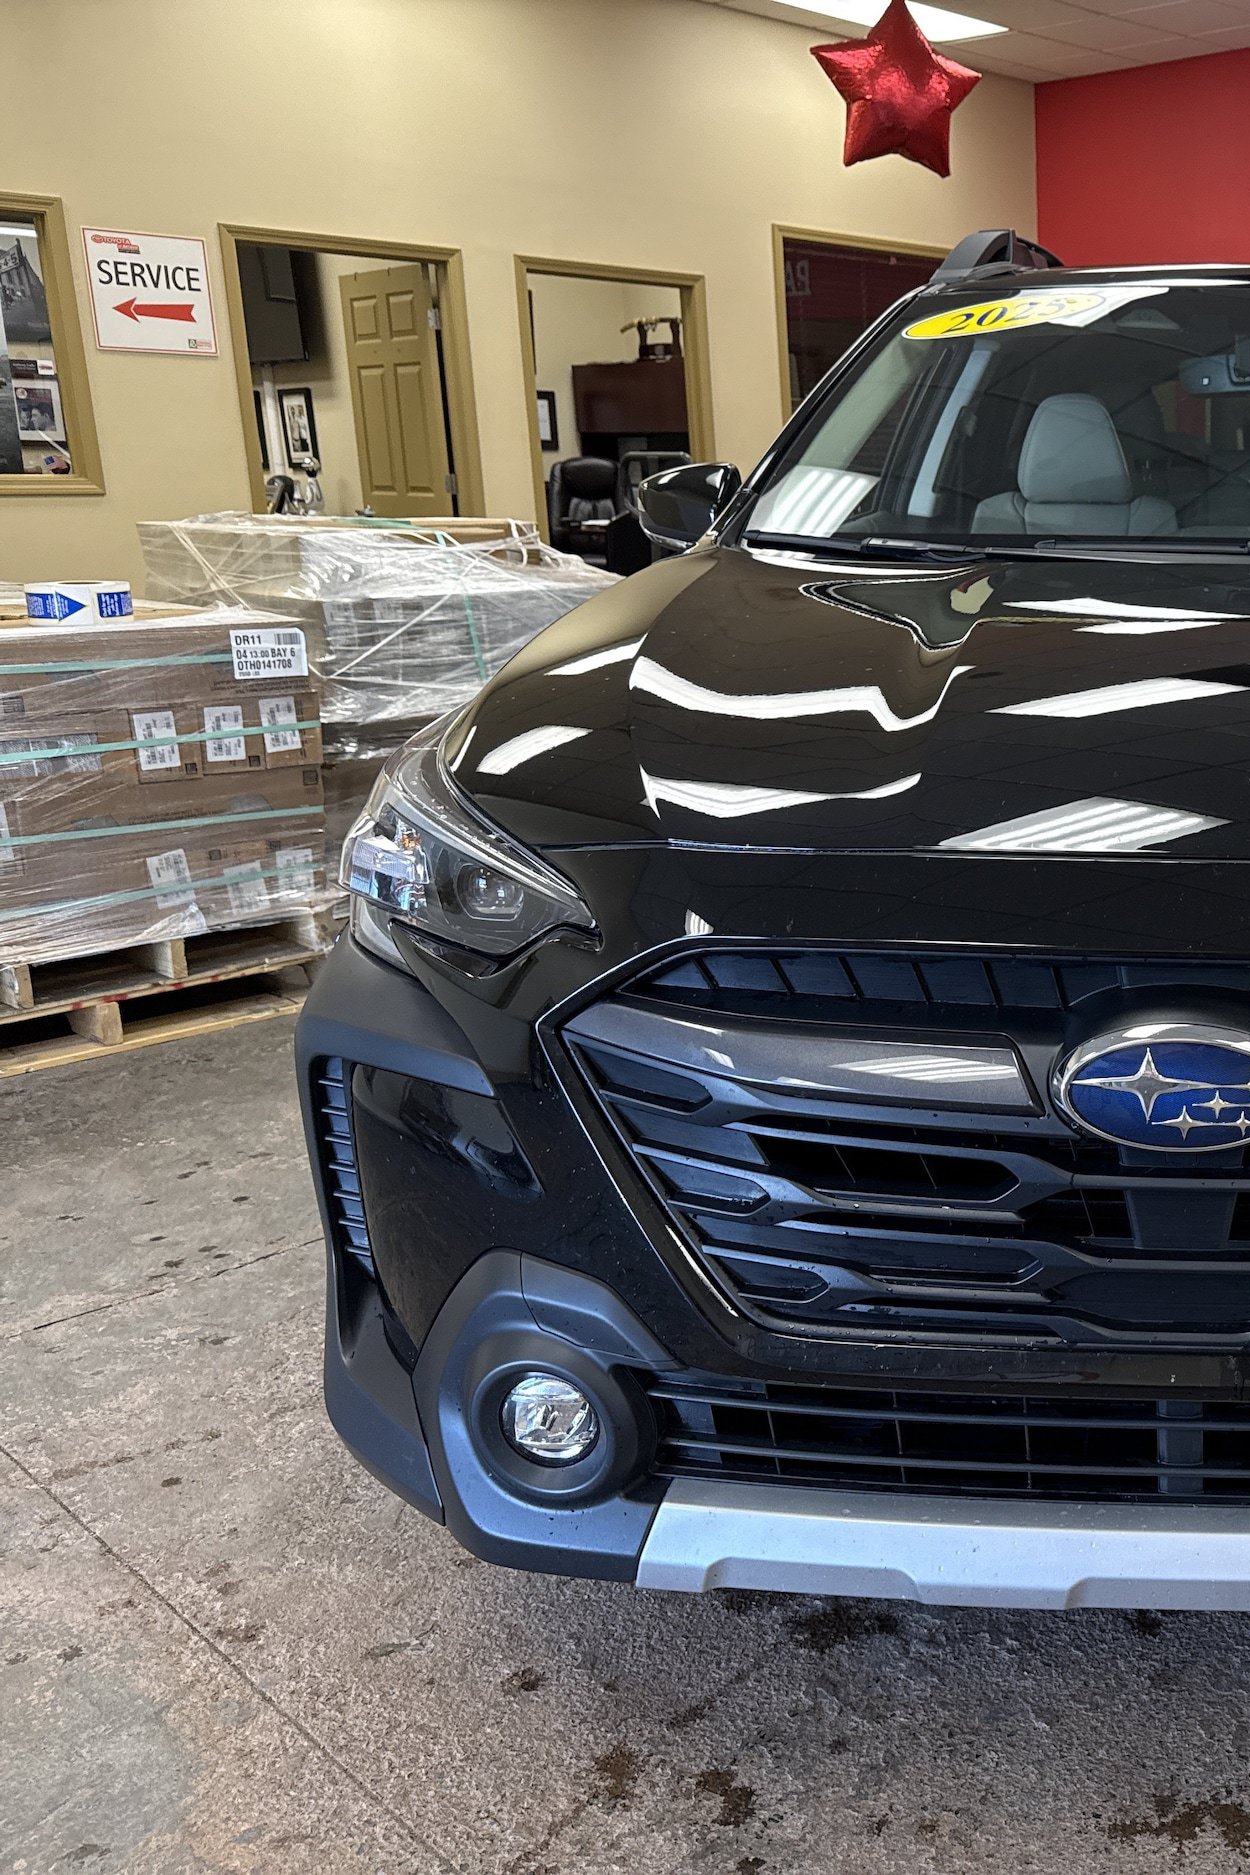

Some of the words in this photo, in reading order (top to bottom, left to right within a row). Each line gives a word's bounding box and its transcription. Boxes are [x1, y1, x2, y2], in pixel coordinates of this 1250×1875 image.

[97, 259, 201, 292] SERVICE
[940, 299, 1067, 334] 2025
[235, 635, 261, 646] DR11
[236, 649, 248, 660] 04
[249, 649, 269, 659] 13:00
[271, 648, 288, 658] BAY
[290, 648, 295, 657] 6
